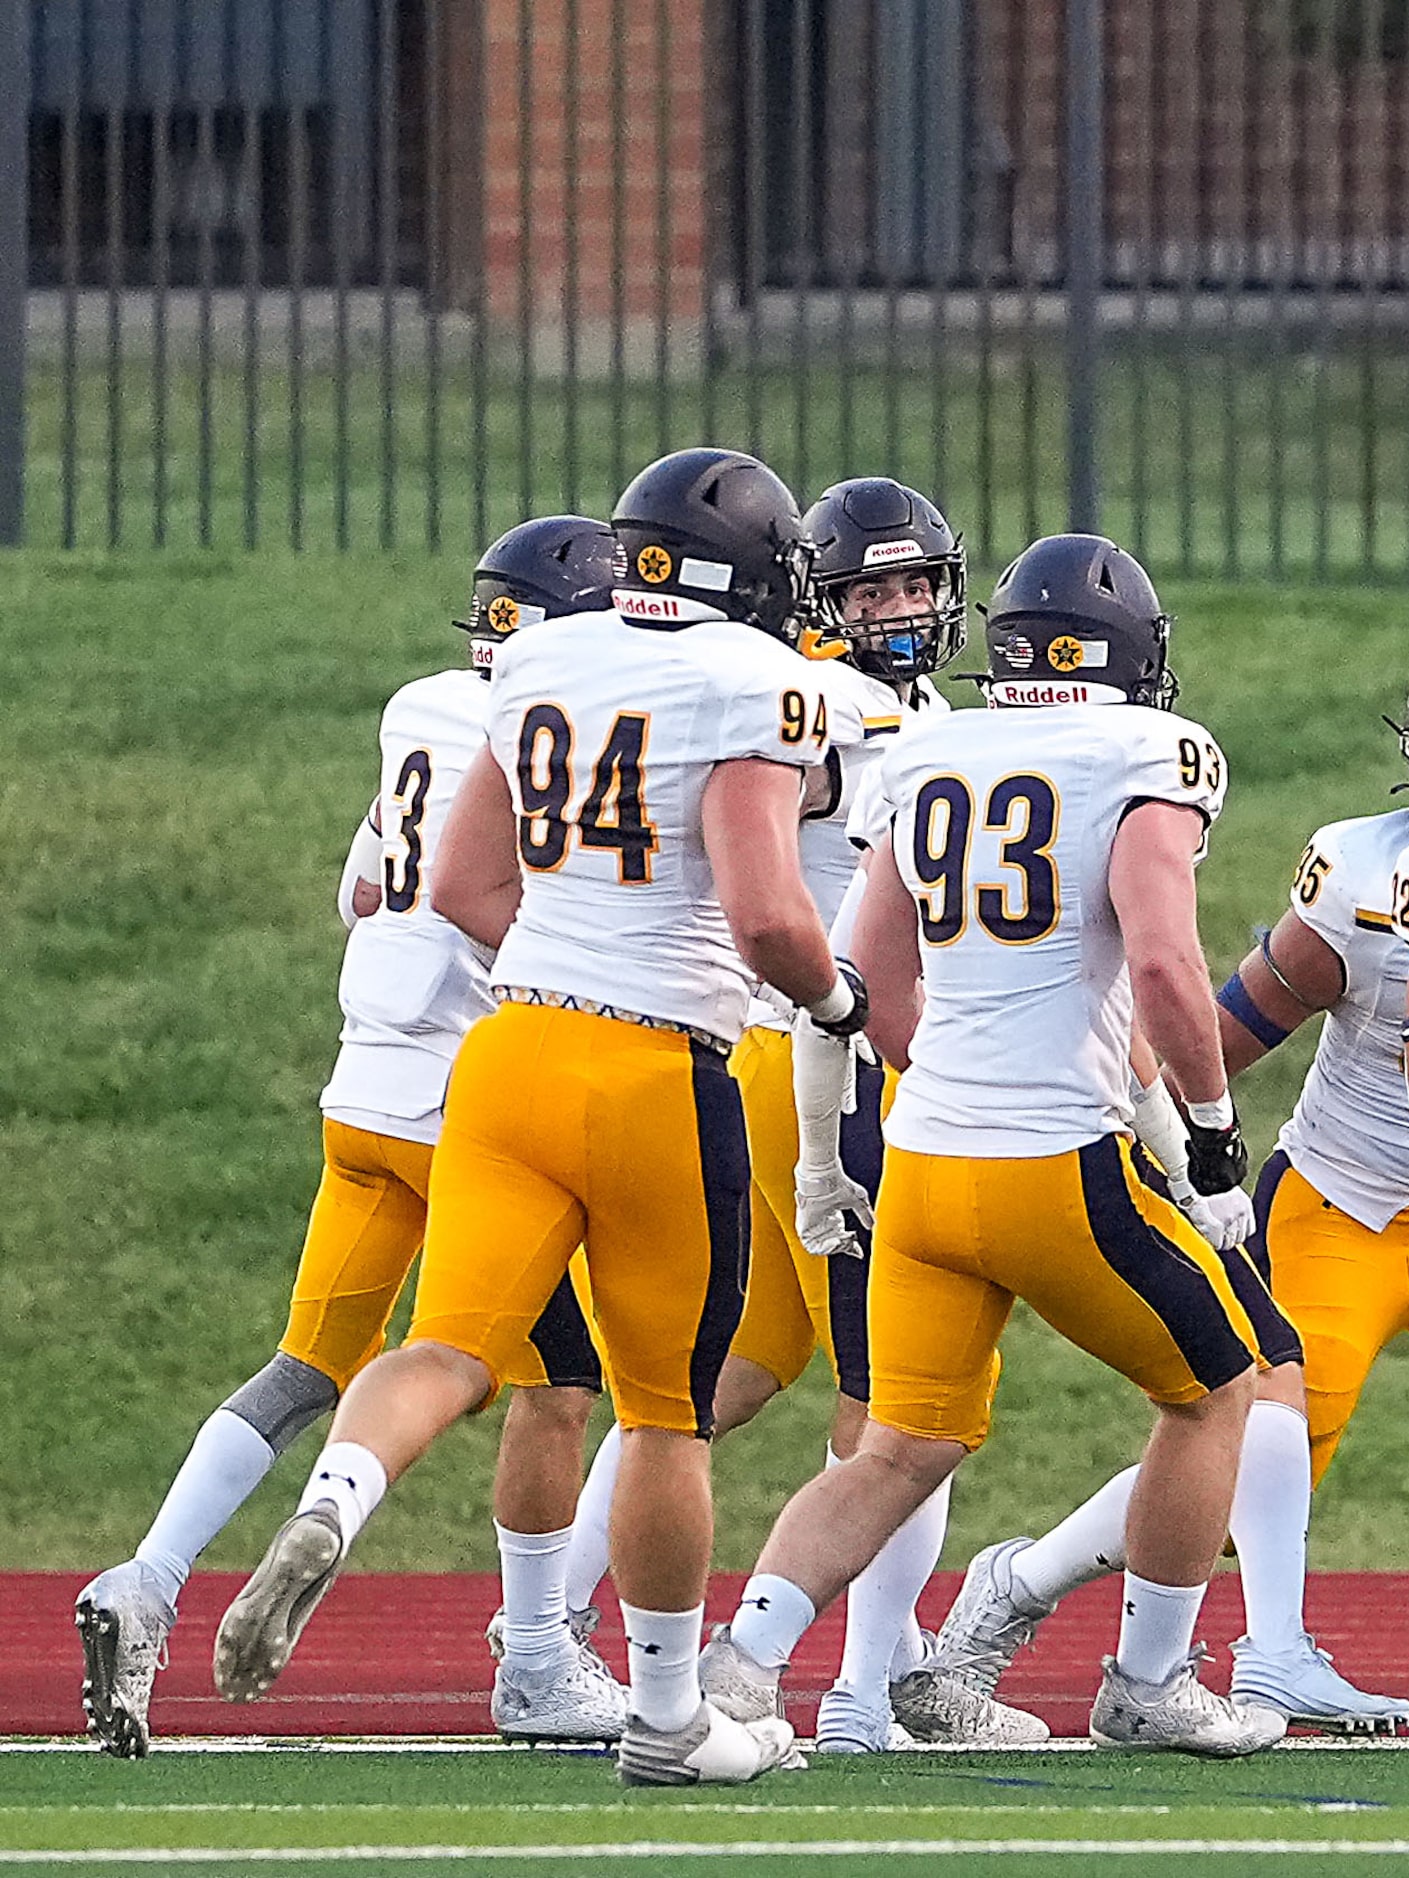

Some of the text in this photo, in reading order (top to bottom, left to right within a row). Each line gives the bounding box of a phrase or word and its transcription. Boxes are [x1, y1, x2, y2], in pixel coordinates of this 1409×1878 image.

[779, 688, 828, 750] 94
[1005, 687, 1088, 704] Riddell
[517, 701, 660, 885] 94
[1178, 737, 1220, 794] 93
[384, 746, 432, 914] 3
[913, 770, 1061, 946] 93
